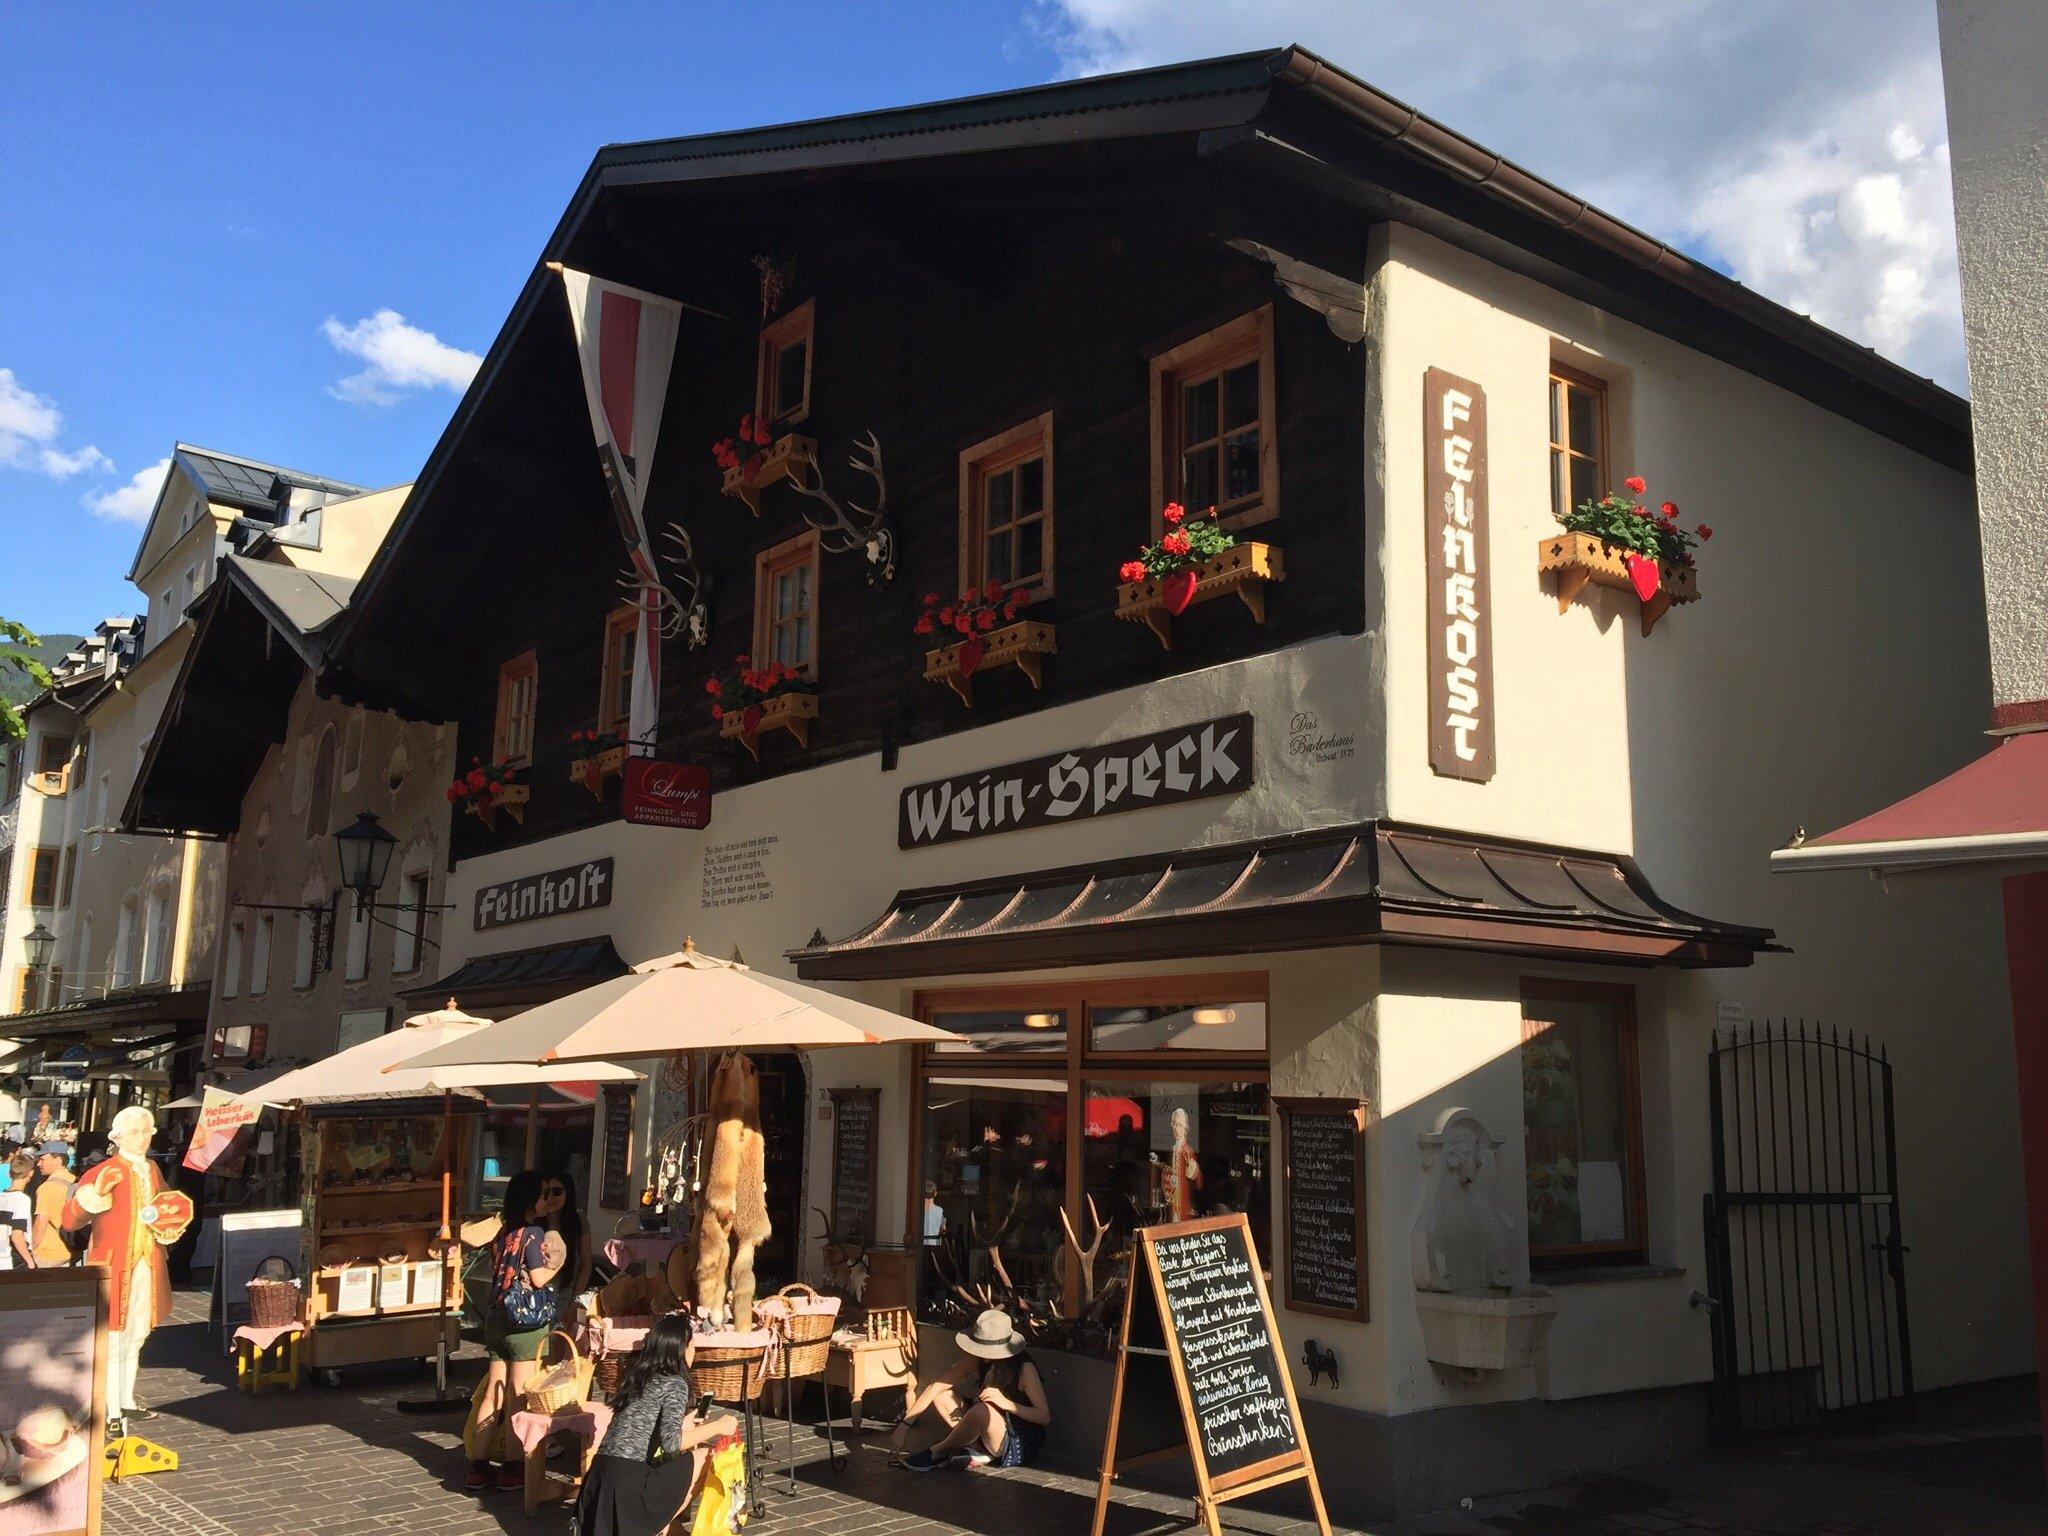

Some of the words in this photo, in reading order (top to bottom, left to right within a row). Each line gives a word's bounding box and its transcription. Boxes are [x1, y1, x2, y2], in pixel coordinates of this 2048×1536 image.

[1290, 711, 1317, 735] Das
[1290, 733, 1354, 755] Baderhaus
[907, 722, 1242, 843] Wein-Speck
[634, 805, 674, 815] FEINKOST
[634, 814, 698, 826] APPARTEMENTS
[205, 1103, 244, 1116] Heisser
[206, 1111, 255, 1127] Leberkäs
[1155, 1242, 1168, 1256] Bei
[1169, 1243, 1181, 1254] uns
[1180, 1238, 1200, 1256] finden
[1200, 1233, 1212, 1246] Sie
[1212, 1234, 1227, 1245] das
[1159, 1255, 1179, 1272] Beste
[1182, 1255, 1193, 1268] der
[1175, 1308, 1211, 1332] Almspeck
[1211, 1307, 1223, 1322] mit
[1223, 1298, 1263, 1319] Knoblauch
[1192, 1377, 1210, 1391] viele
[1210, 1370, 1229, 1386] tolle
[1228, 1364, 1256, 1381] Sorten
[1242, 1374, 1272, 1394] Honig
[1203, 1405, 1241, 1437] frischer
[1243, 1396, 1287, 1420] saftiger
